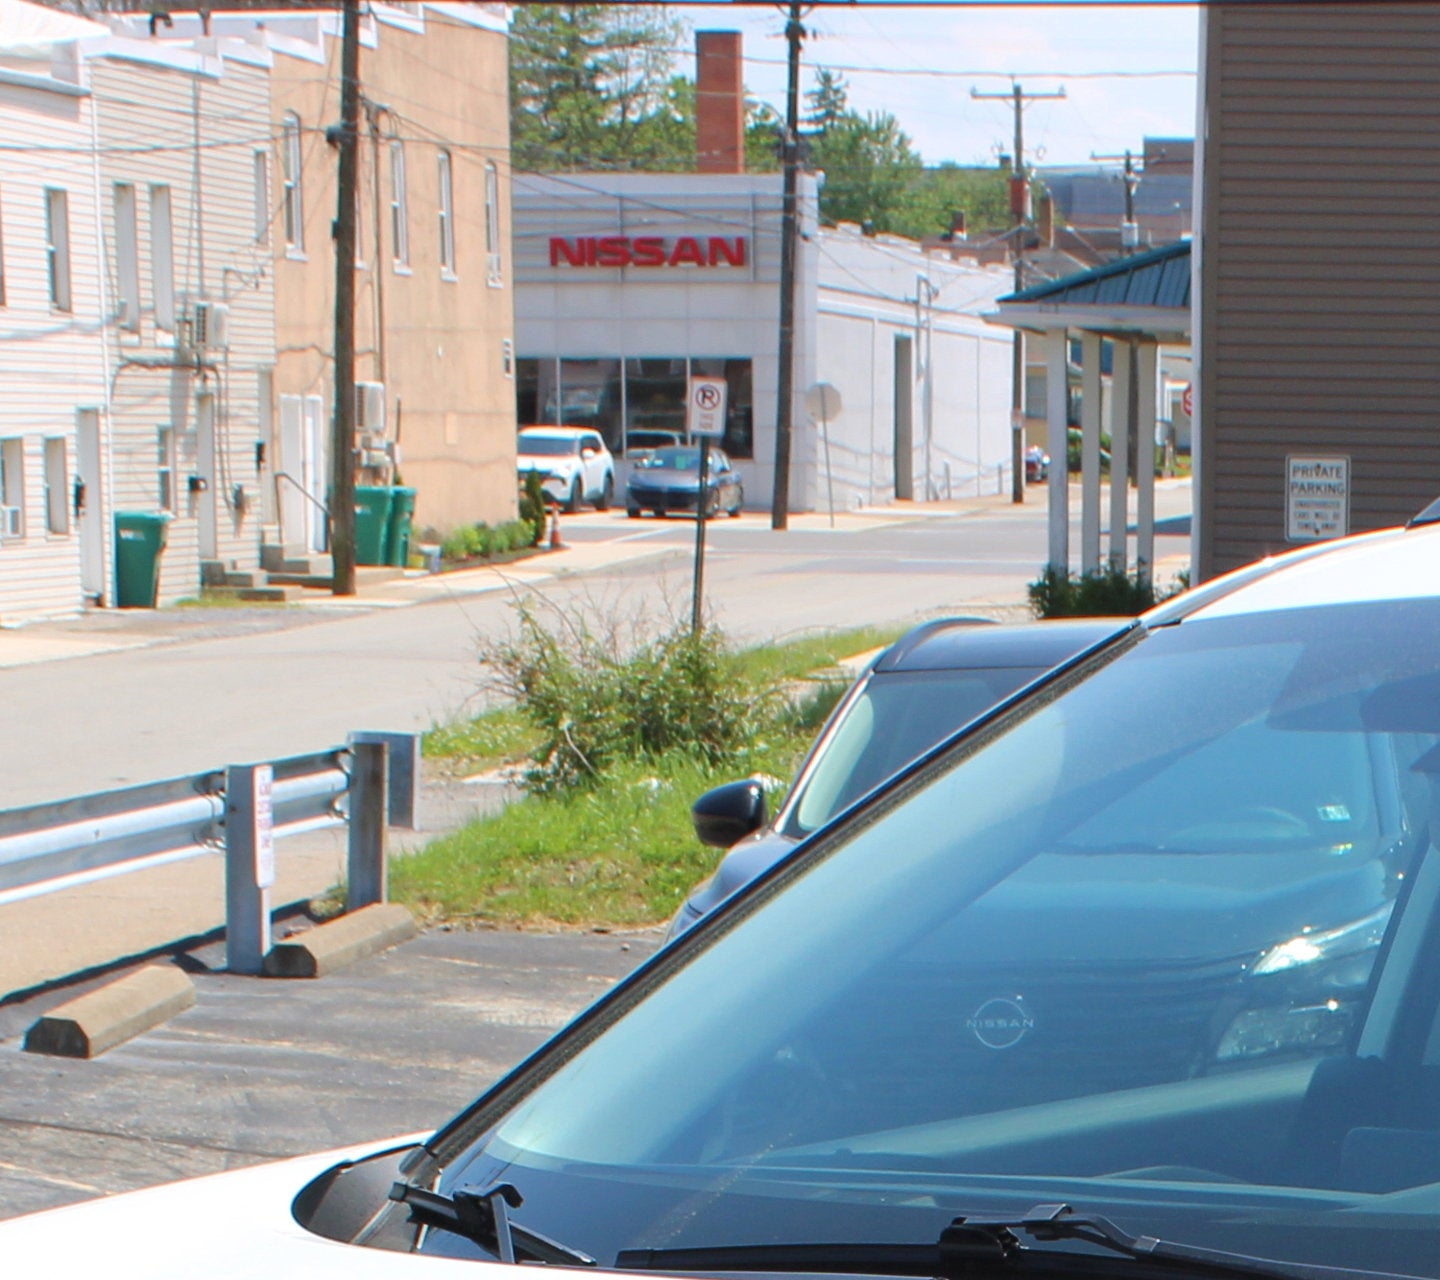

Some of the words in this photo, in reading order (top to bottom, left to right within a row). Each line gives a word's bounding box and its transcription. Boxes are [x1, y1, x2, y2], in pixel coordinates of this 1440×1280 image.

[549, 236, 746, 266] NISSAN
[1292, 464, 1343, 479] PRIVATE
[1290, 481, 1345, 495] PARKING
